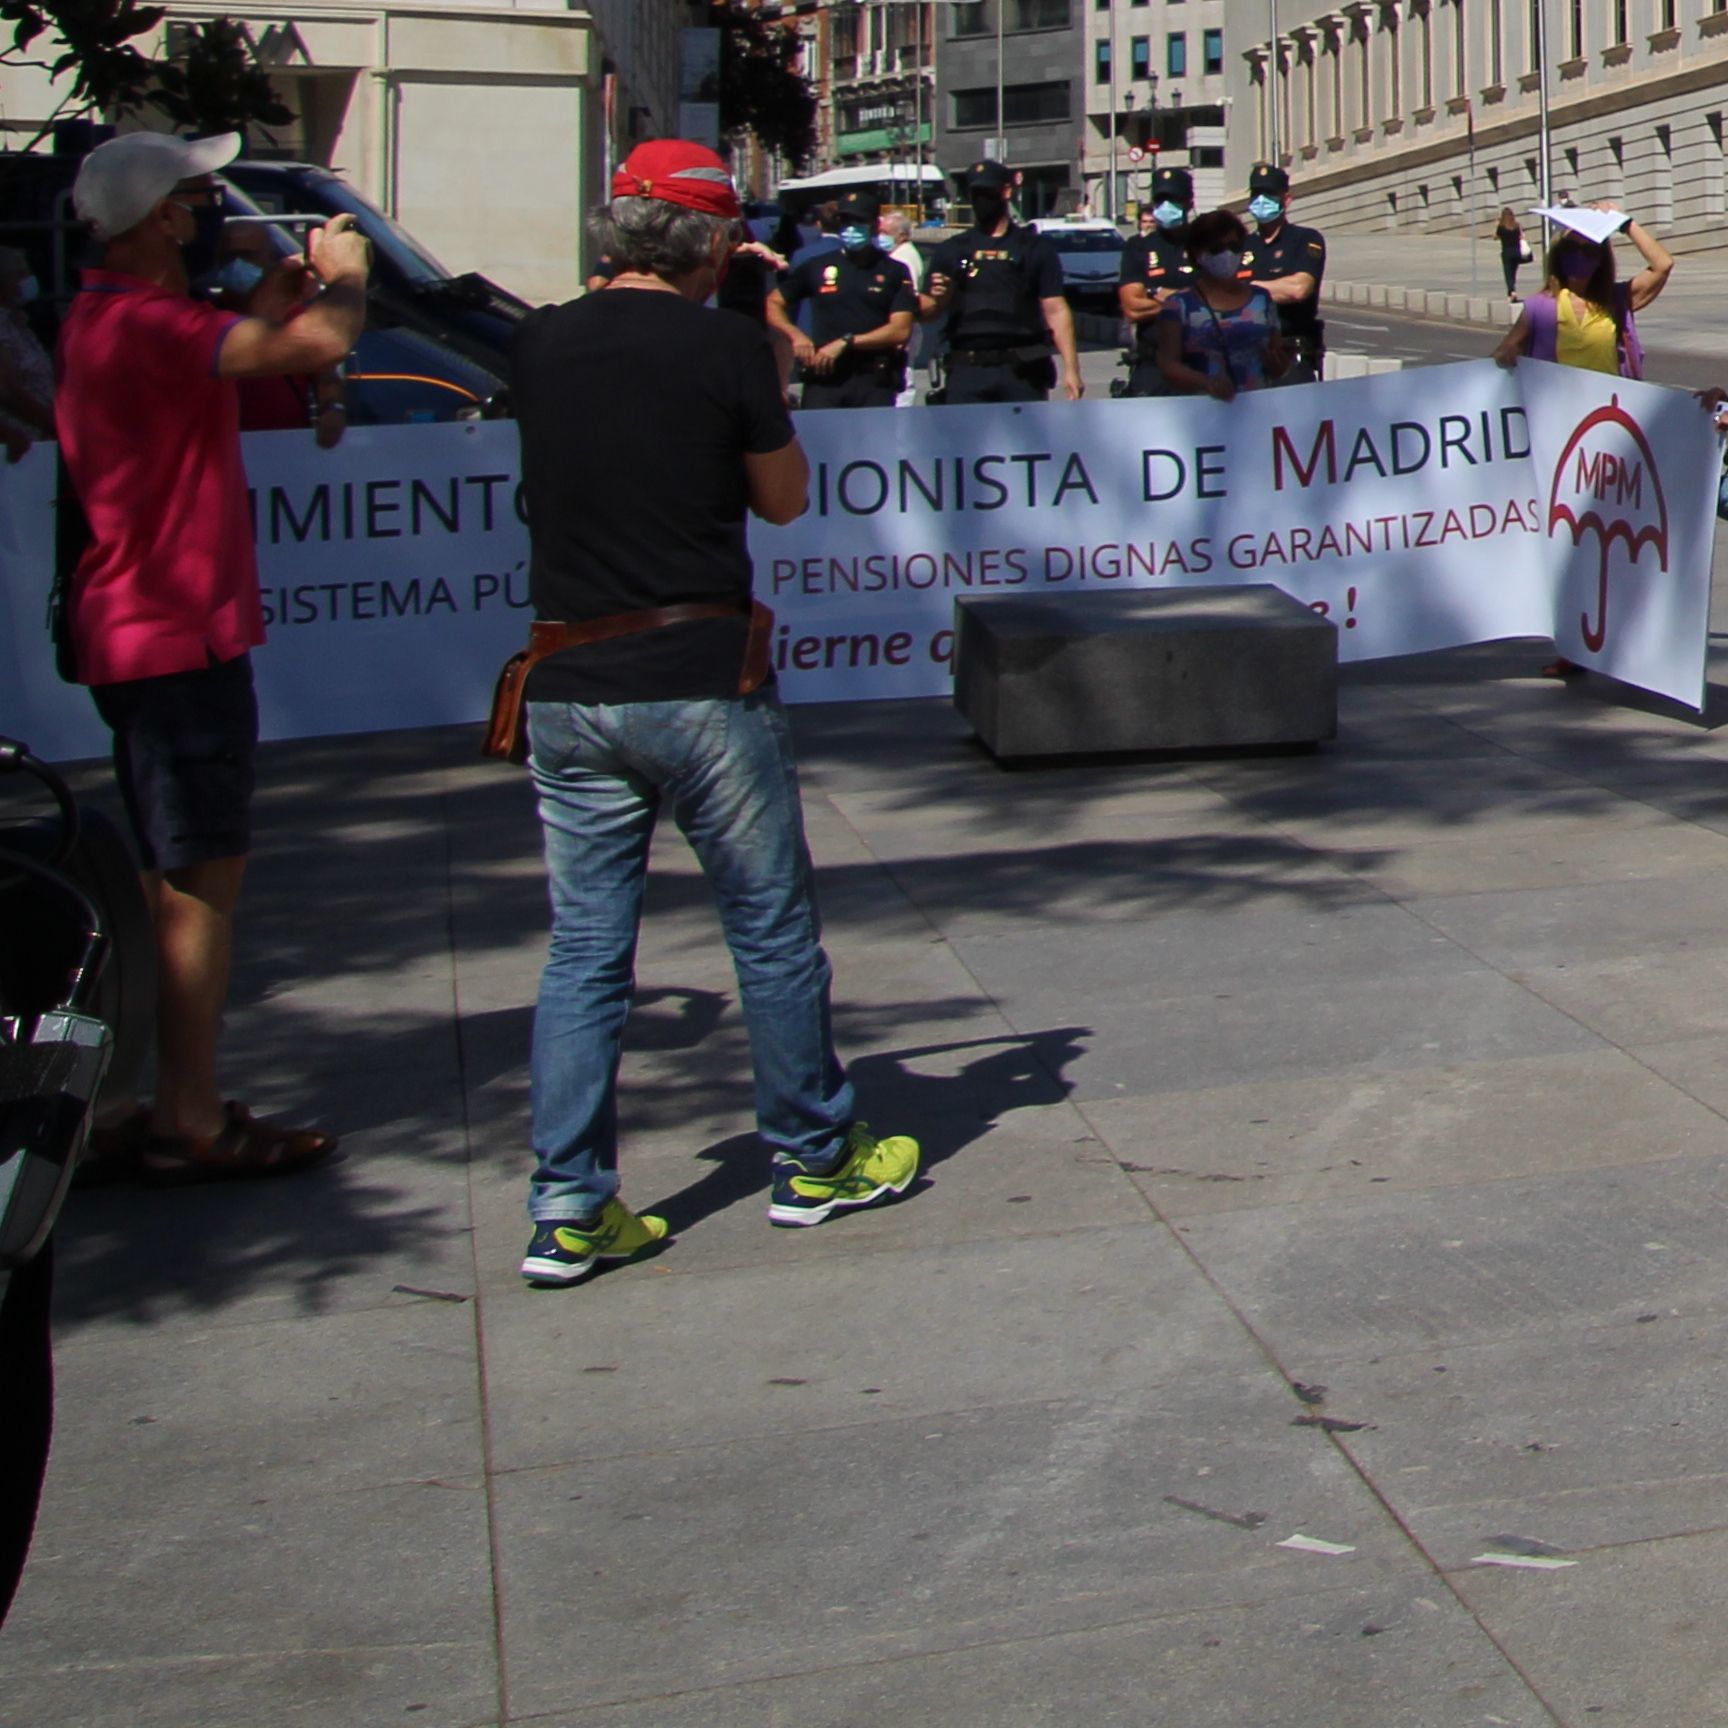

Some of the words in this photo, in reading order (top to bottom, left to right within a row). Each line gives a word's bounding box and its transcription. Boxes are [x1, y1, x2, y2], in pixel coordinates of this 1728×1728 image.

[248, 473, 530, 545] IMIENT
[804, 450, 1099, 518] IONISTA
[1141, 443, 1229, 503] DE
[1574, 446, 1642, 511] MPM
[772, 547, 1028, 596] PENSIONES
[1044, 537, 1213, 584] DIGNAS
[1227, 498, 1541, 569] GARANTIZADAS
